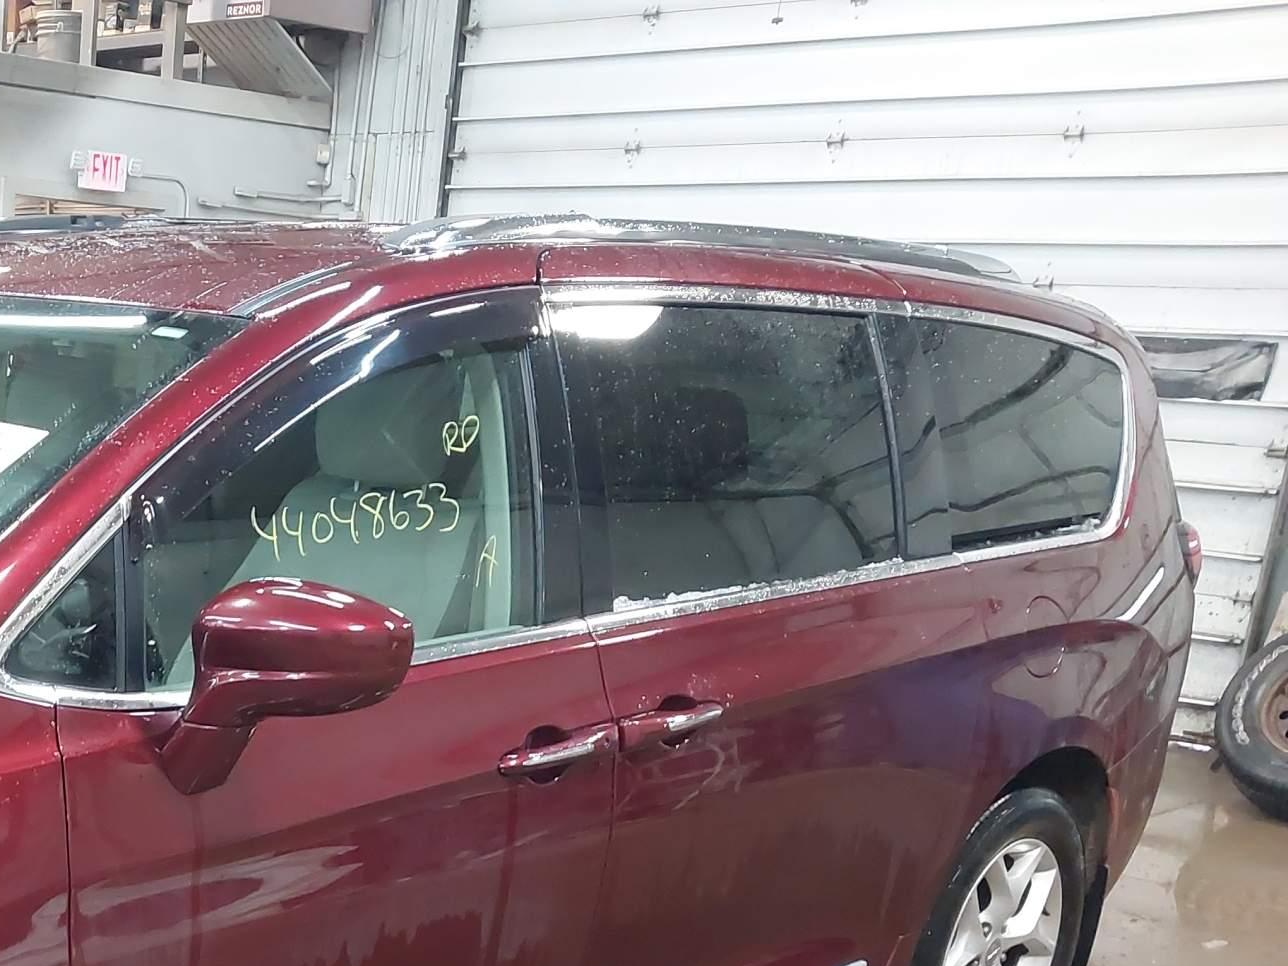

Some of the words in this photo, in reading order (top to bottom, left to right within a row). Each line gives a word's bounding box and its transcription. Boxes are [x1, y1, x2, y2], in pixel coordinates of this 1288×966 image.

[227, 3, 262, 16] REZNOR
[250, 482, 460, 562] 44048633
[476, 535, 499, 588] A
